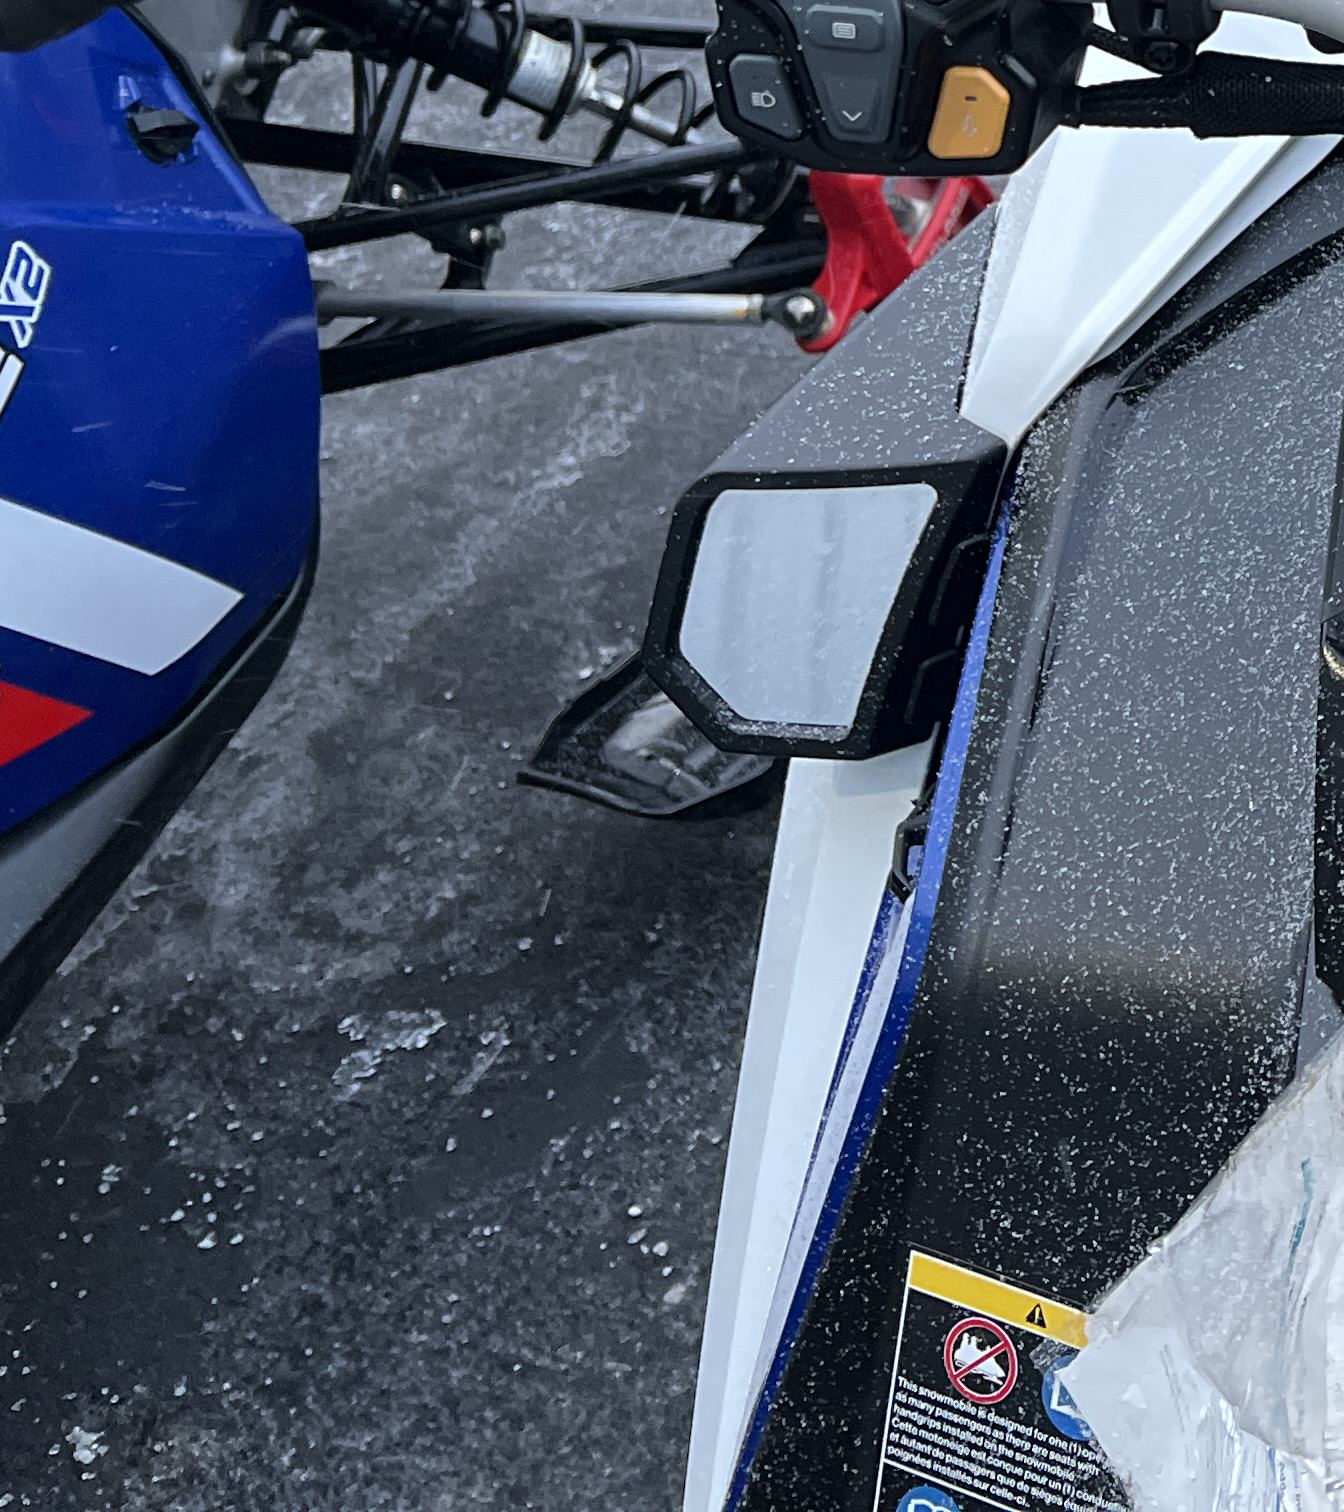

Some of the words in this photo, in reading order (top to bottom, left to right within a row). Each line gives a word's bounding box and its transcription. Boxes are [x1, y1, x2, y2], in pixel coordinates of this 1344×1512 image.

[893, 1403, 942, 1430] handgrips
[942, 1422, 984, 1447] installed
[984, 1440, 998, 1452] on
[998, 1444, 1014, 1459] the
[898, 1376, 918, 1393] This
[918, 1386, 977, 1416] snowmobile
[977, 1407, 987, 1419] is
[987, 1409, 1033, 1437] designed
[1034, 1428, 1048, 1441] for
[1049, 1436, 1068, 1449] one
[1069, 1441, 1081, 1456] (1)
[908, 1396, 935, 1415] many
[935, 1407, 992, 1435] passengers
[992, 1429, 1004, 1440] as
[1005, 1432, 1031, 1450] there
[1032, 1444, 1048, 1457] are
[1049, 1450, 1076, 1467] seats
[1077, 1461, 1100, 1476] with
[891, 1417, 918, 1436] Cette
[919, 1429, 970, 1456] motoneige
[971, 1448, 987, 1461] est
[1024, 1470, 1048, 1486] pour
[1048, 1479, 1061, 1491] un
[932, 1448, 945, 1459] de
[945, 1453, 996, 1480] passagers
[997, 1474, 1016, 1488] que
[1017, 1480, 1030, 1493] de
[973, 1479, 990, 1491] sur
